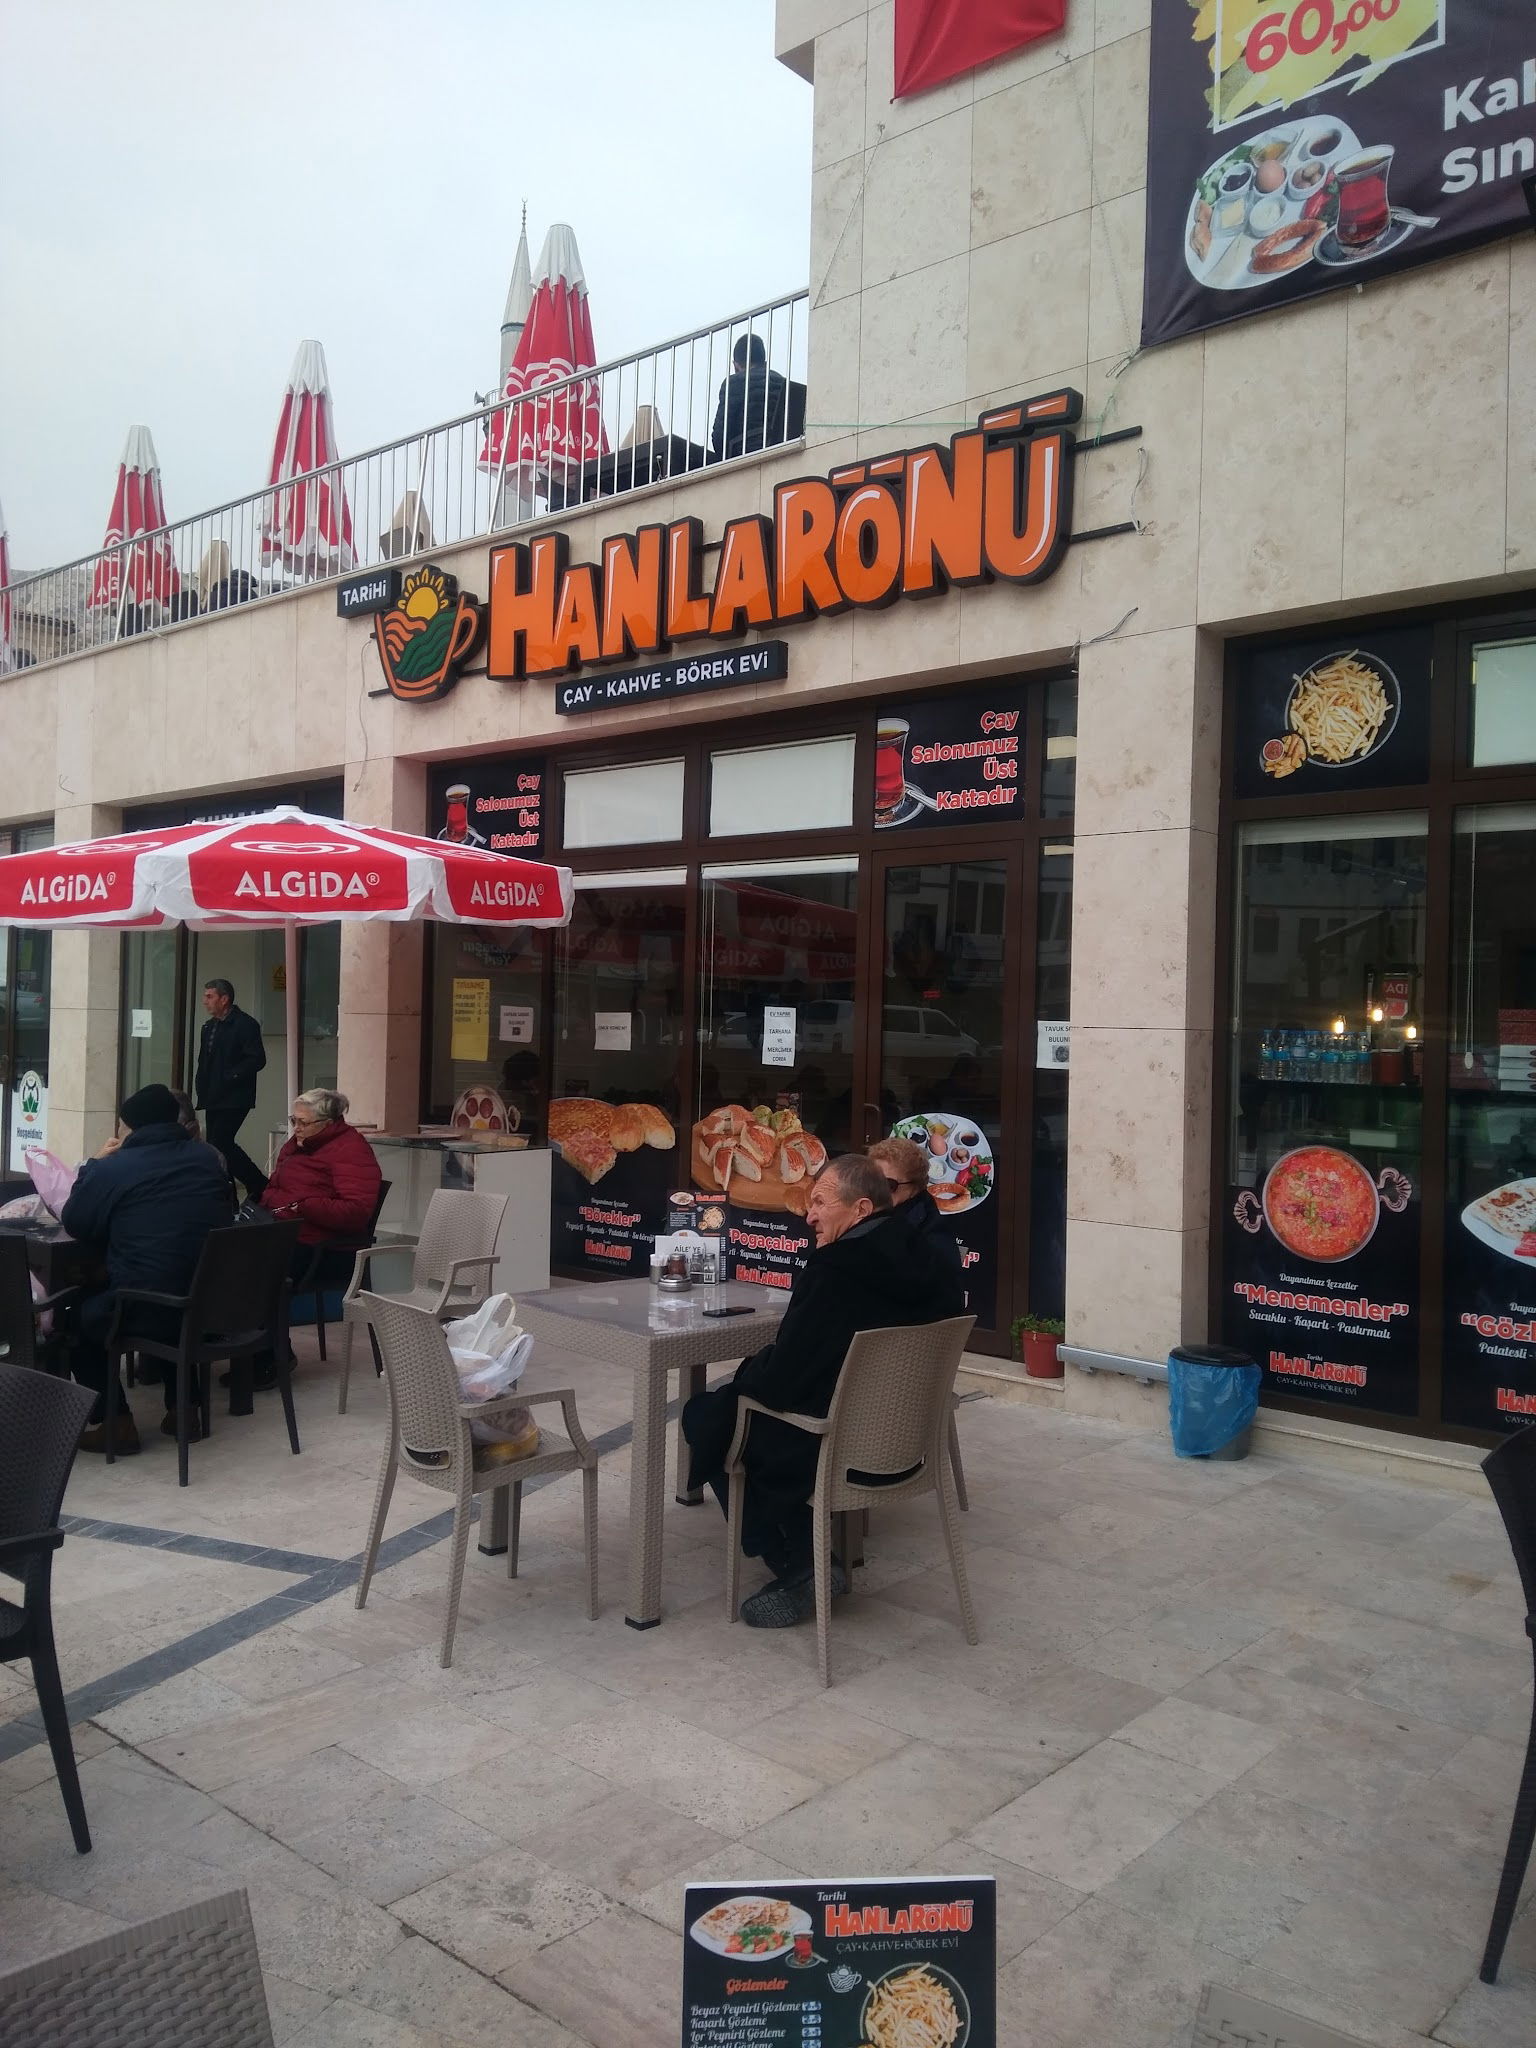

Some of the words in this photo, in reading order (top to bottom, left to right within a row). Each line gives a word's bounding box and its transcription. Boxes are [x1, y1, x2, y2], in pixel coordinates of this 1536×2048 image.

[488, 394, 1069, 679] HANLARÖNÜ
[563, 685, 594, 707] ÇAY
[606, 672, 661, 697] KAHVE
[676, 658, 735, 685] BÖREK
[981, 711, 1019, 734] Çay
[911, 737, 1018, 764] Salonumuz
[983, 757, 1017, 780] Üst
[517, 774, 541, 791] Çay
[476, 795, 540, 813] Salonumuz
[937, 785, 1017, 811] Kattadır
[519, 809, 540, 827] Üst
[491, 831, 539, 849] Kattadır
[1279, 1273, 1325, 1287] Dayanılmaz
[1326, 1279, 1359, 1291] Lezzetler
[1233, 1282, 1409, 1322] “Menemenler”
[1249, 1309, 1287, 1324] Sucuklu
[1293, 1315, 1330, 1331] Kaşarlı
[1337, 1321, 1391, 1339] Pastırmalı
[1478, 1341, 1527, 1359] Patatesli
[817, 1892, 847, 1902] Tarihi
[825, 1900, 974, 1937] HANLARÖNÜ
[726, 1977, 789, 1995] Gözlemeler
[690, 2005, 720, 2018] Beyaz
[722, 2002, 760, 2017] Peynirli
[761, 2001, 801, 2015] Gözleme
[690, 2018, 726, 2031] Kaşarlı
[728, 2015, 767, 2029] Gözleme
[707, 2029, 746, 2043] Peynirli
[747, 2028, 787, 2041] Gözleme
